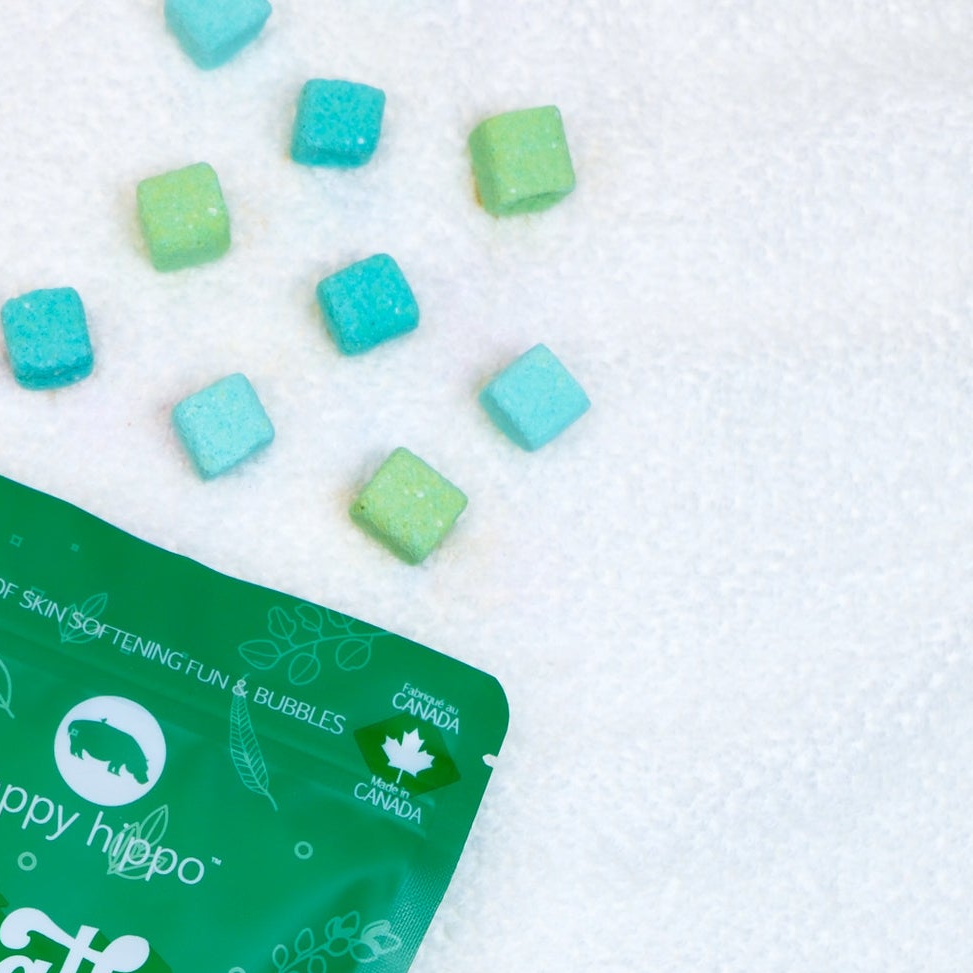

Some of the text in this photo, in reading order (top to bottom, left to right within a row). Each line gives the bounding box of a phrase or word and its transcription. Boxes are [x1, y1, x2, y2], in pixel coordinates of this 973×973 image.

[19, 590, 67, 623] SKIN
[66, 611, 183, 671] SOFTENING
[185, 659, 230, 690] FUN
[232, 678, 248, 698] &
[253, 686, 347, 735] BUBBLES
[392, 692, 460, 735] CANADA
[402, 682, 459, 715] Fabriqué au
[353, 782, 422, 824] CANADA
[370, 775, 410, 799] Made in
